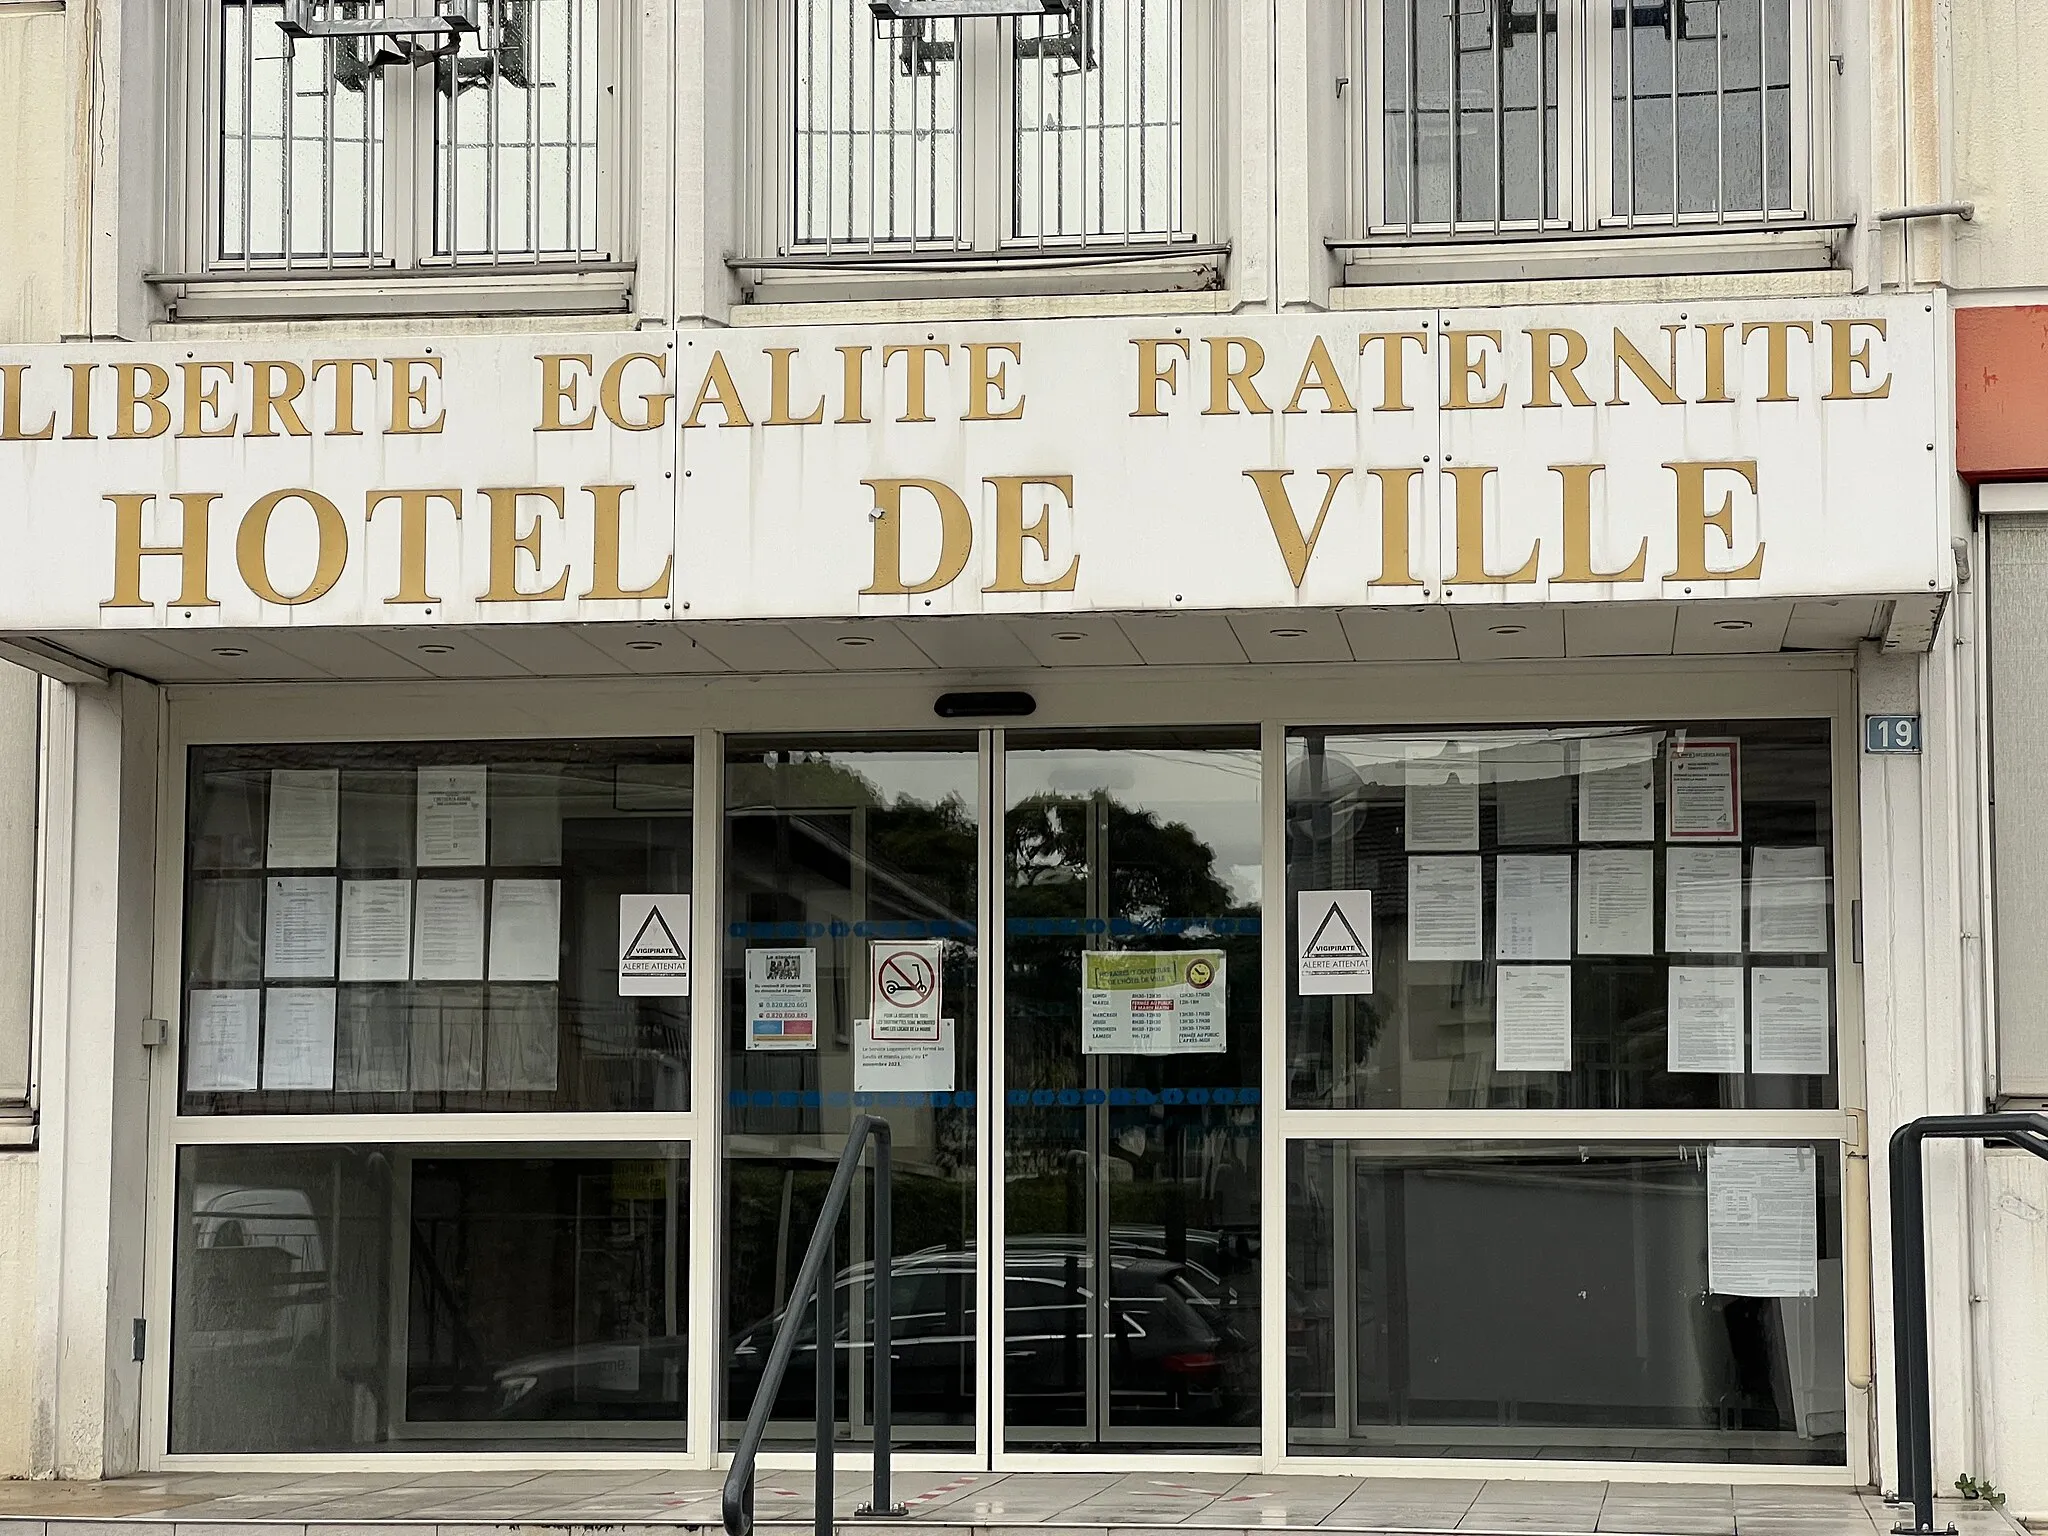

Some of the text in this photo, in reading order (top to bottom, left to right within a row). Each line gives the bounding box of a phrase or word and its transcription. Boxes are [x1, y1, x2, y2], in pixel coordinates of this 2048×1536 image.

[0, 317, 1892, 441] LIBERTE EGALITE FRATERNITE
[100, 459, 1766, 607] HOTEL DE VILLE
[1878, 720, 1912, 747] 19
[1302, 960, 1368, 968] ALERTE ATTENTAT
